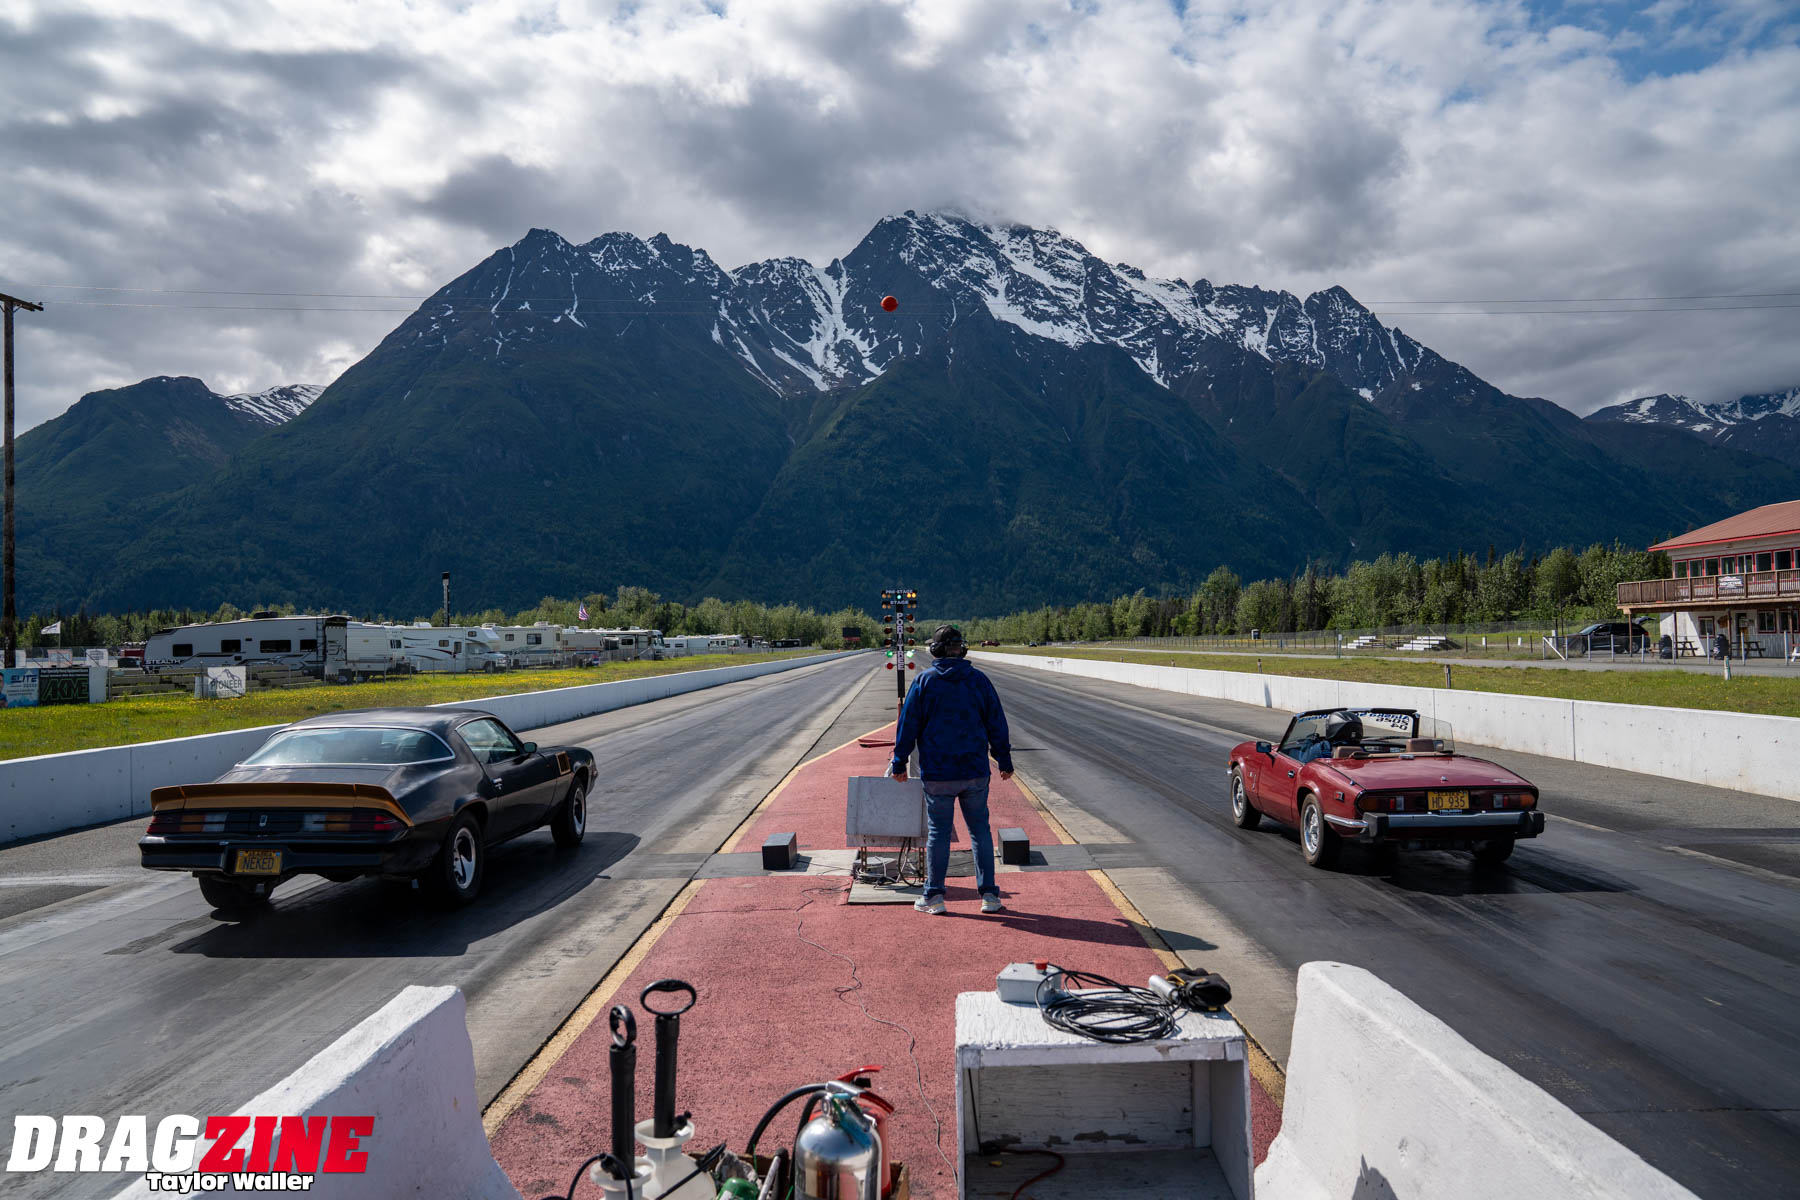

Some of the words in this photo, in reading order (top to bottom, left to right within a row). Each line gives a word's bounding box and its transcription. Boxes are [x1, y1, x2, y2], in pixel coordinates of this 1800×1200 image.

[11, 674, 38, 683] ELITE
[210, 679, 243, 690] PIONEER
[1448, 796, 1465, 808] 935
[243, 856, 274, 870] NEKED
